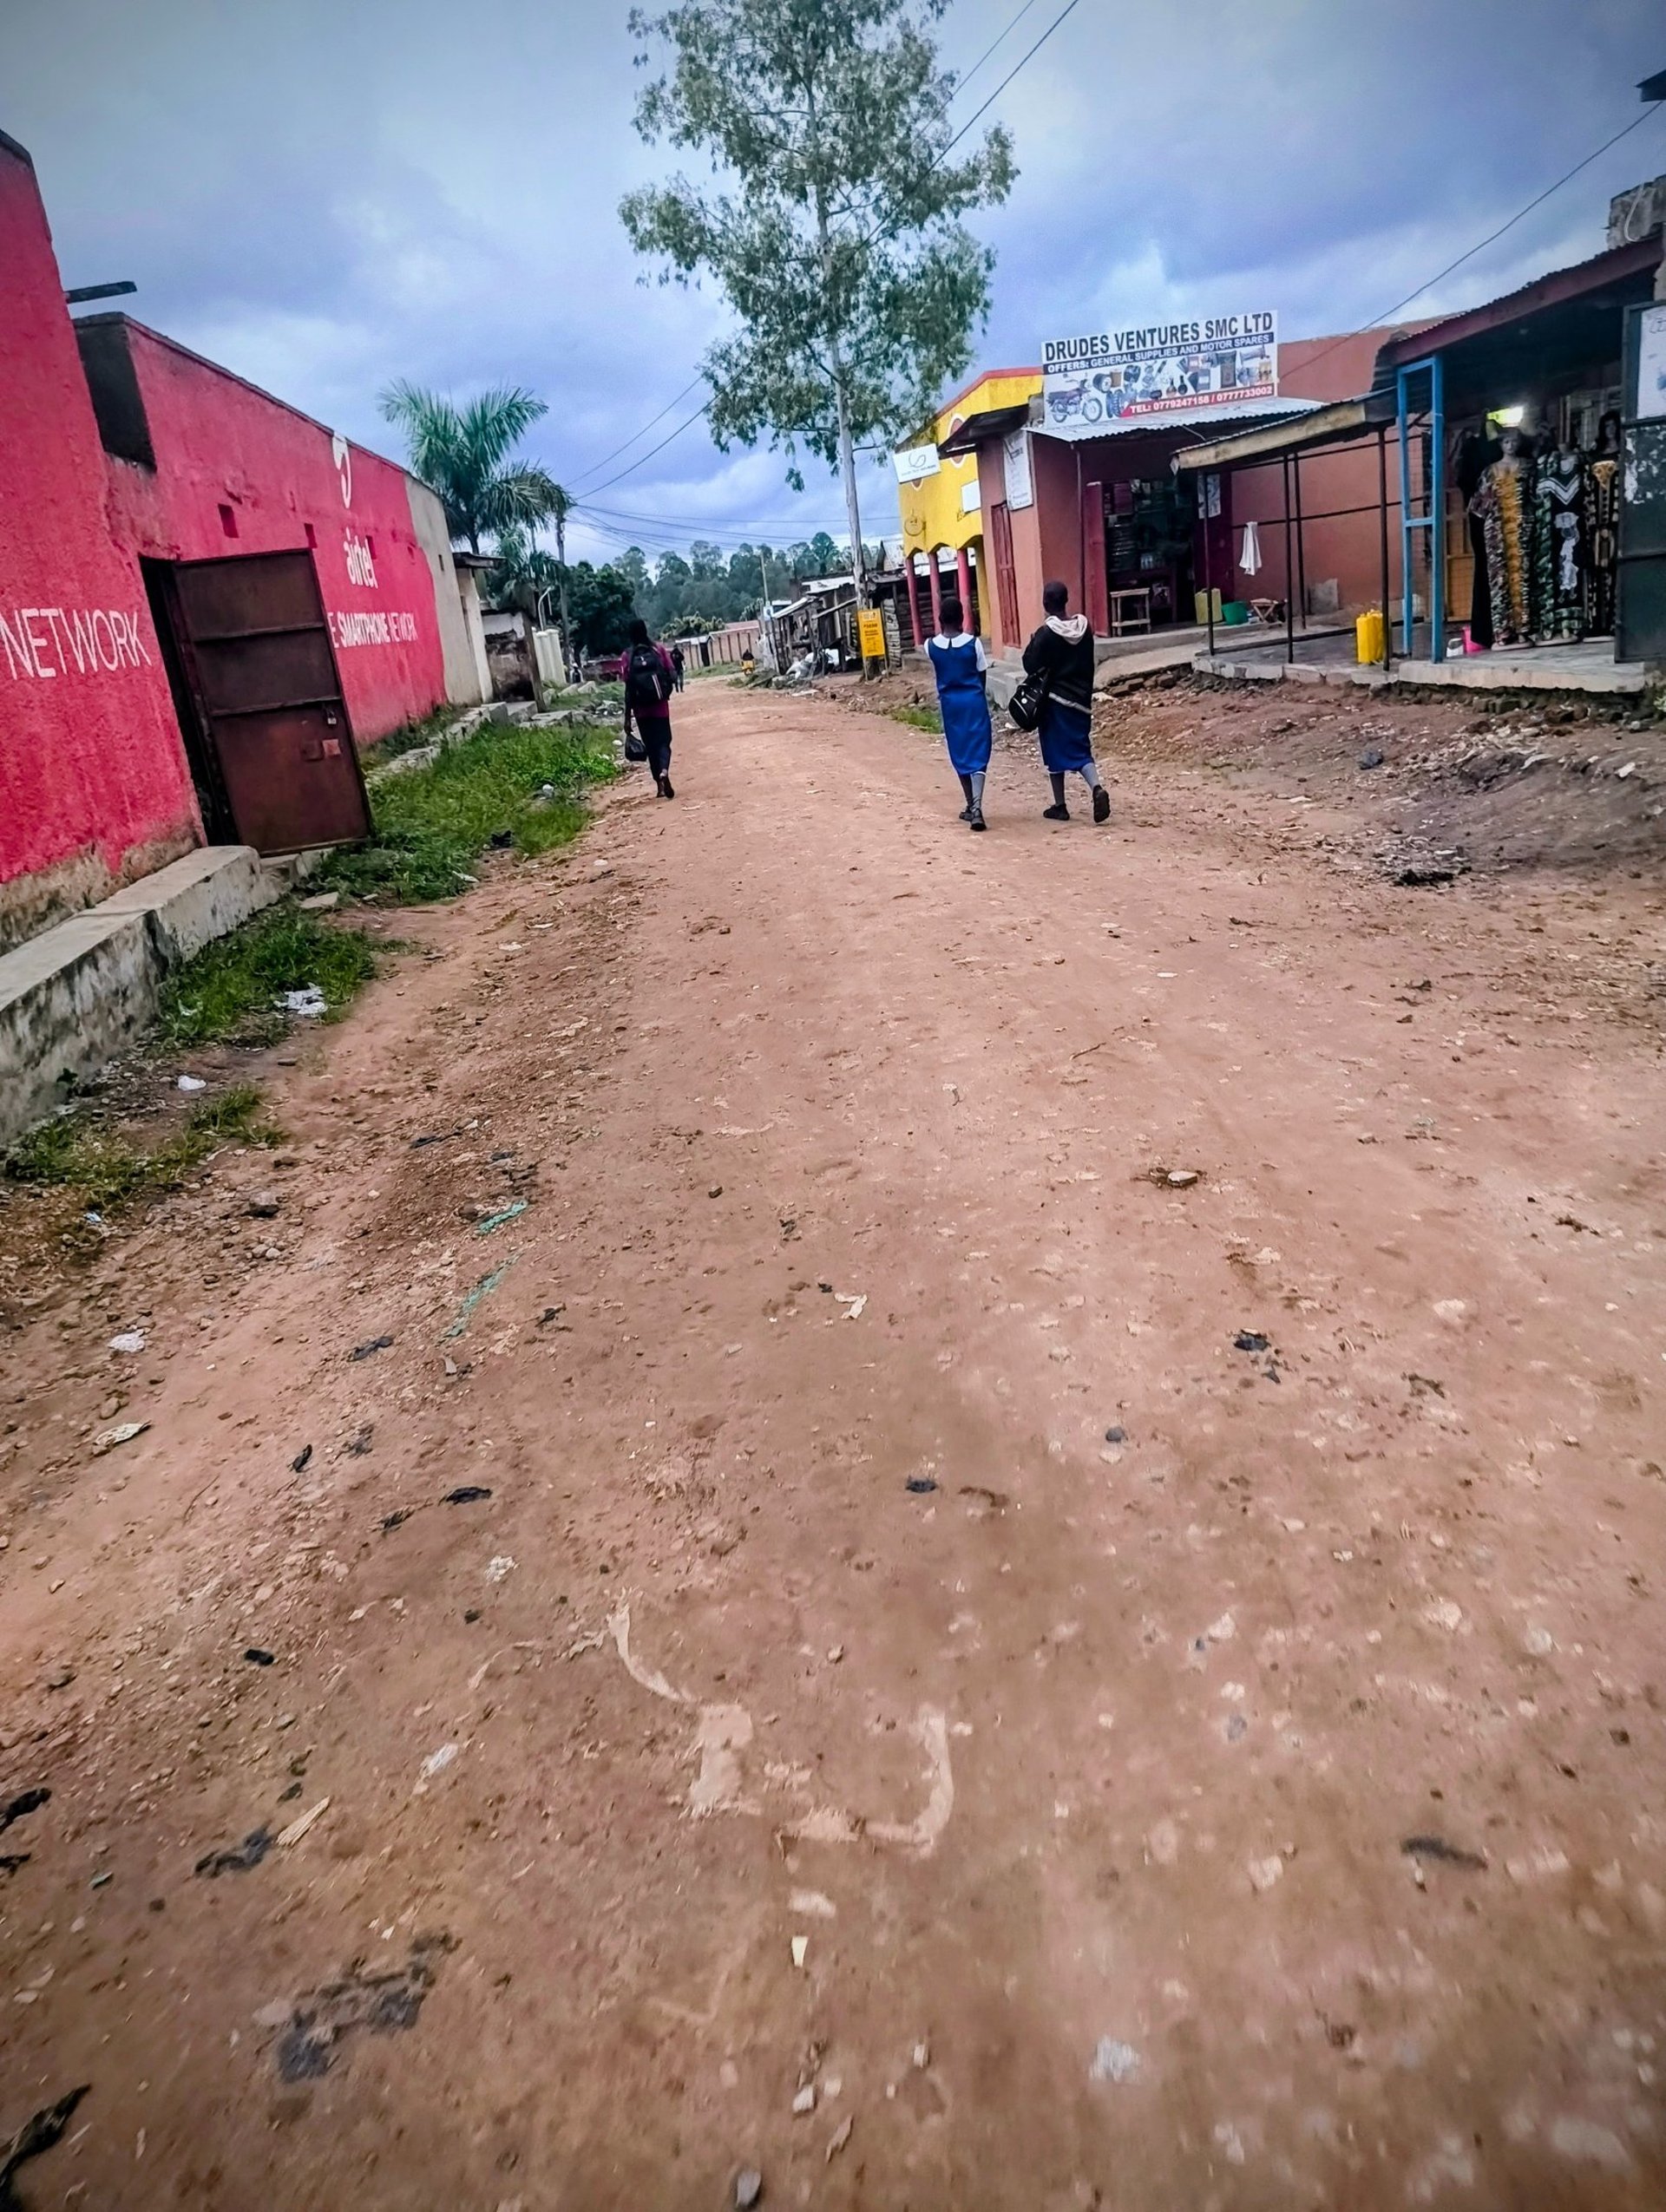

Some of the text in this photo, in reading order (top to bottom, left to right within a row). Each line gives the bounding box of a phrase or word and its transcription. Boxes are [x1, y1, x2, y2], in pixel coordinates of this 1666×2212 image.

[1045, 311, 1274, 362] DRUDES VENTURES SMC LTD
[1047, 335, 1269, 373] OFFERS: GENERAL SUPPLIES AND MOTOR SPARES
[1130, 404, 1151, 414] TEL:
[343, 527, 379, 589] airtel
[0, 607, 153, 680] NETWORK
[337, 611, 391, 648] SMARTPHONE
